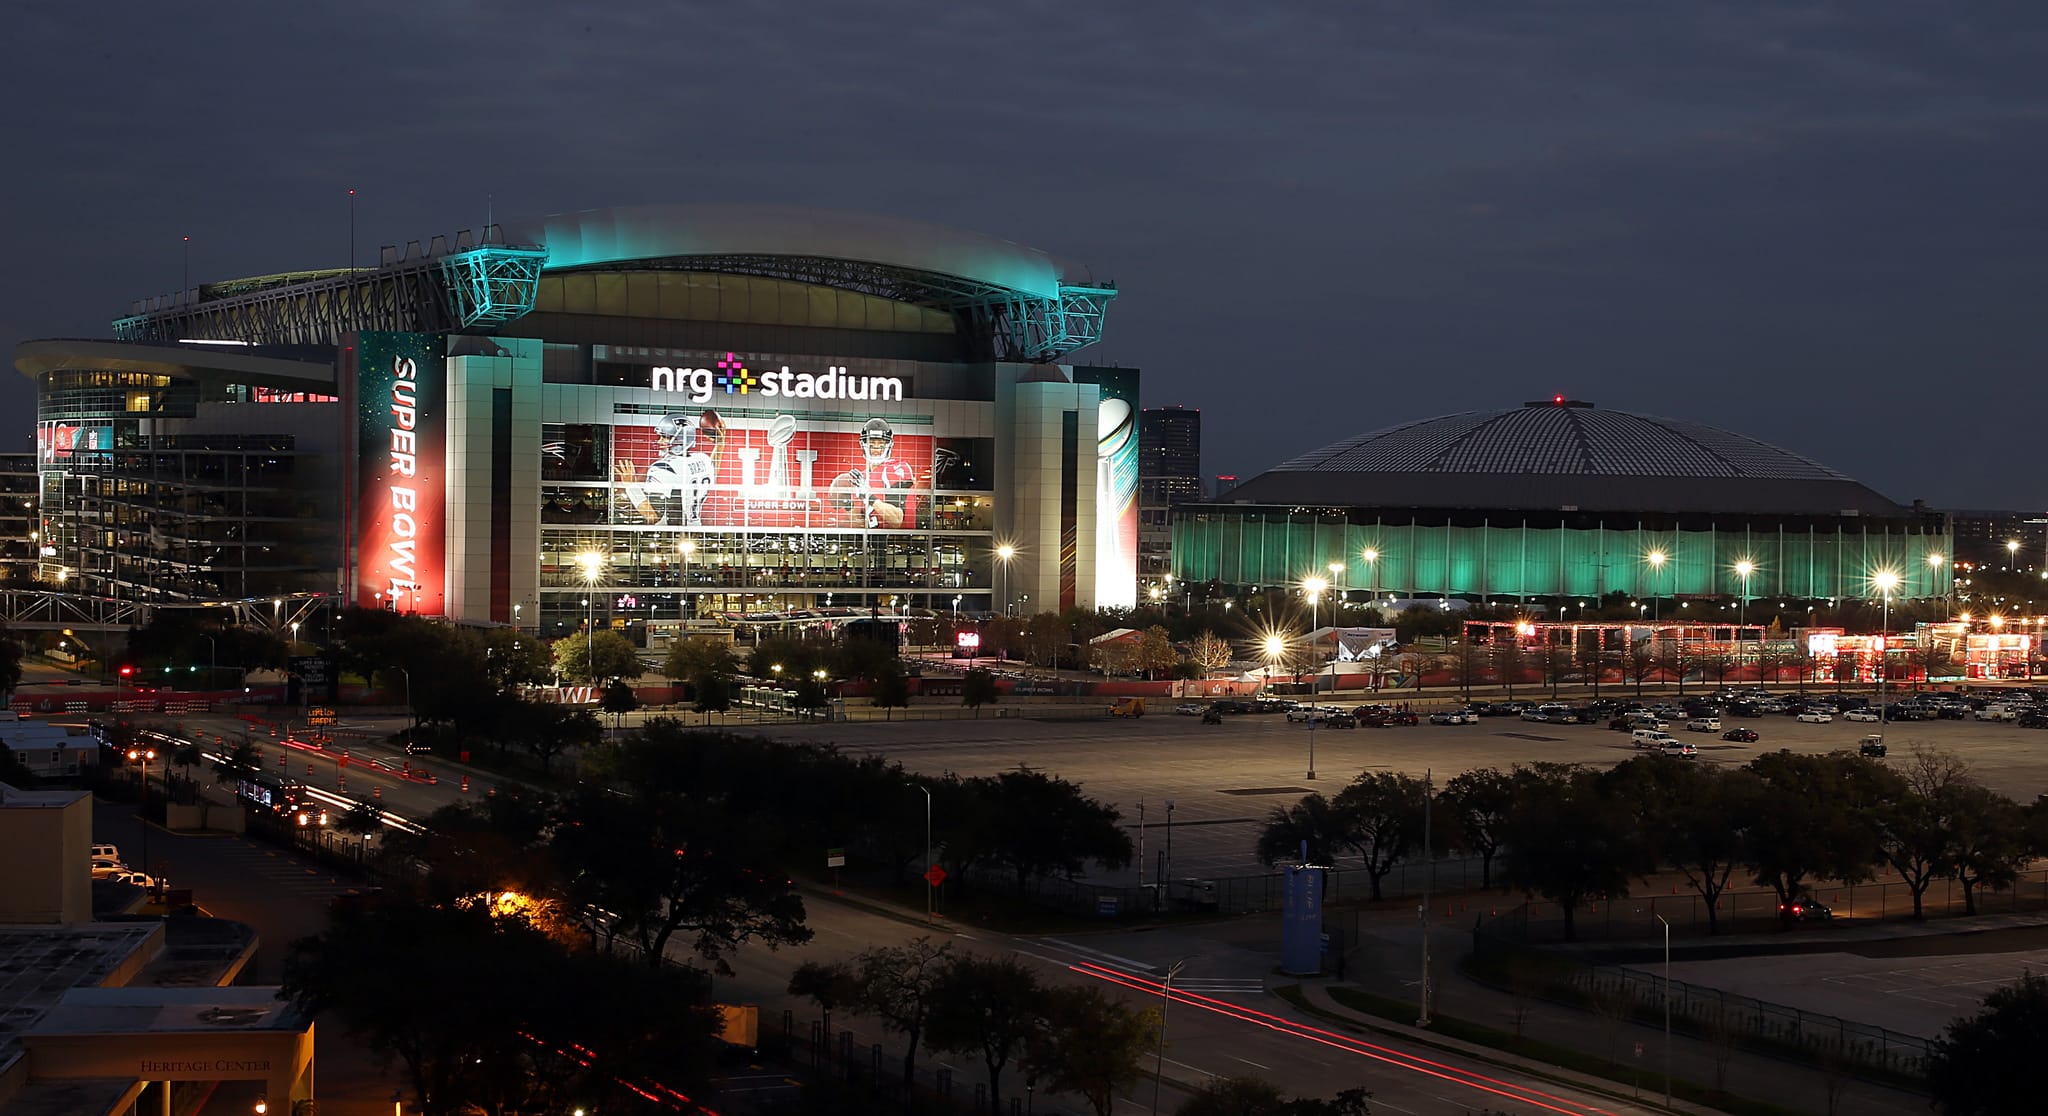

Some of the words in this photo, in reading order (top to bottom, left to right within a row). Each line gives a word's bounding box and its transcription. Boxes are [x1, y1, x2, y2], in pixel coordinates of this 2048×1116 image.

[390, 354, 417, 479] SUPER
[652, 366, 713, 403] nrg
[760, 366, 903, 401] stadium
[389, 486, 417, 612] BOWL
[140, 1060, 212, 1072] HERITAGE
[215, 1060, 271, 1072] CENTER
